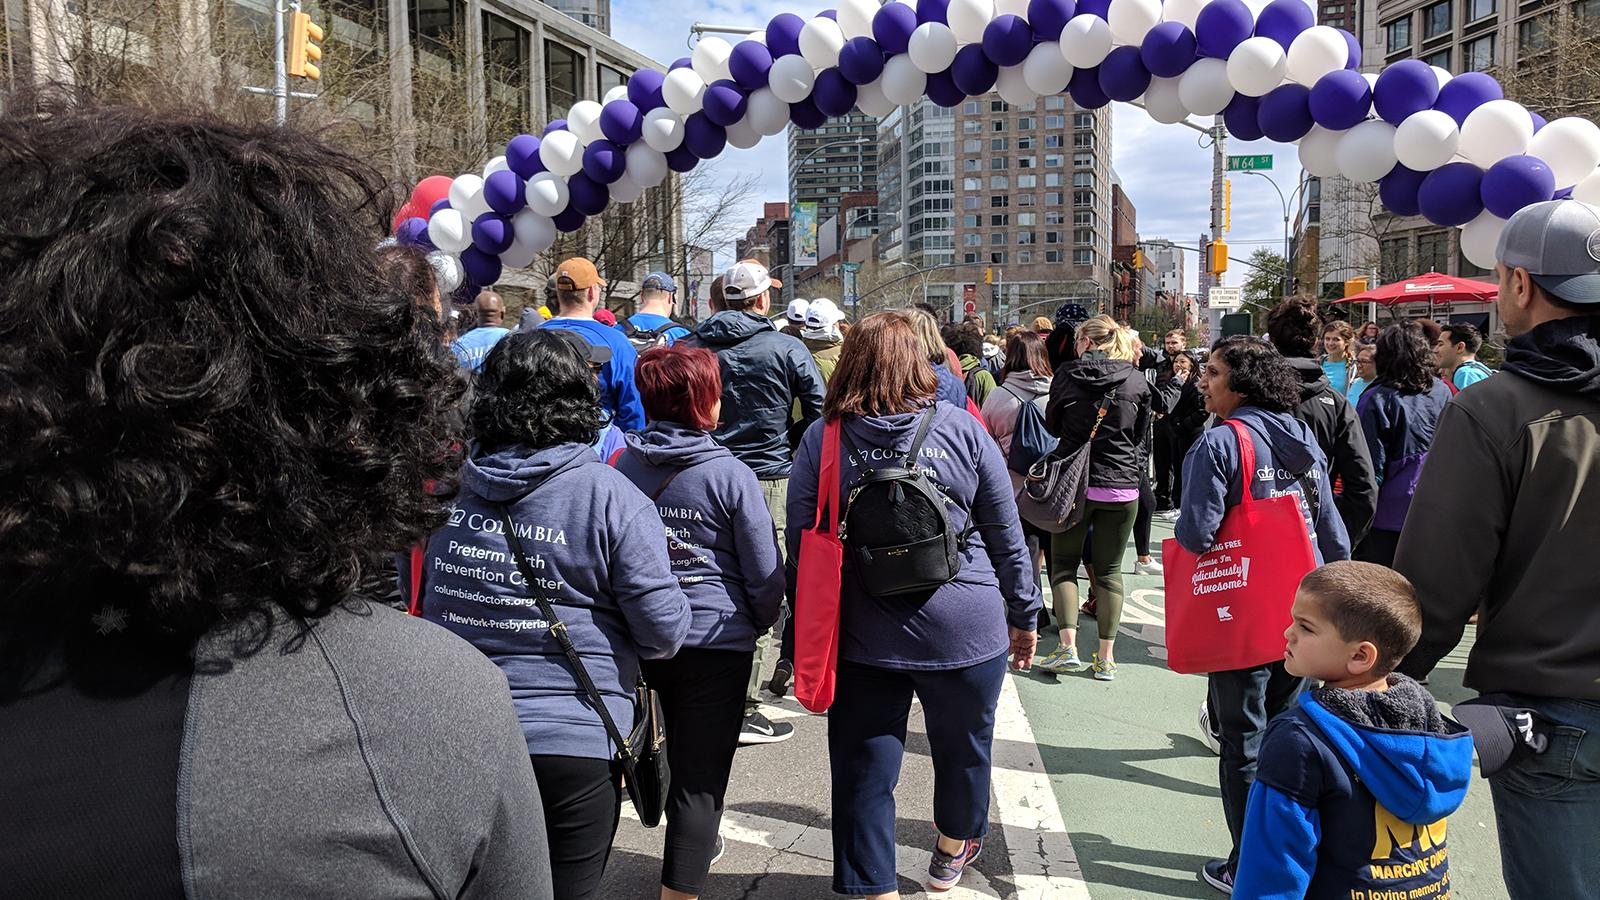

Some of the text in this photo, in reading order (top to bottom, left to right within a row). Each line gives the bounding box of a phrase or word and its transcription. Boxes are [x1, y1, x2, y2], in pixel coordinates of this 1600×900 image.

[1231, 157, 1239, 169] W
[1241, 157, 1254, 169] 64
[871, 448, 949, 460] COLBIA
[660, 506, 703, 521] UMBIA
[467, 513, 568, 546] COLMBIA
[665, 526, 691, 538] Birth
[448, 540, 506, 563] Preterm
[1224, 539, 1243, 550] FREE
[434, 557, 505, 584] Prevention
[1369, 861, 1421, 880] MARCH
[1350, 889, 1365, 900] In
[1368, 889, 1407, 900] loving
[1409, 880, 1441, 899] memory
